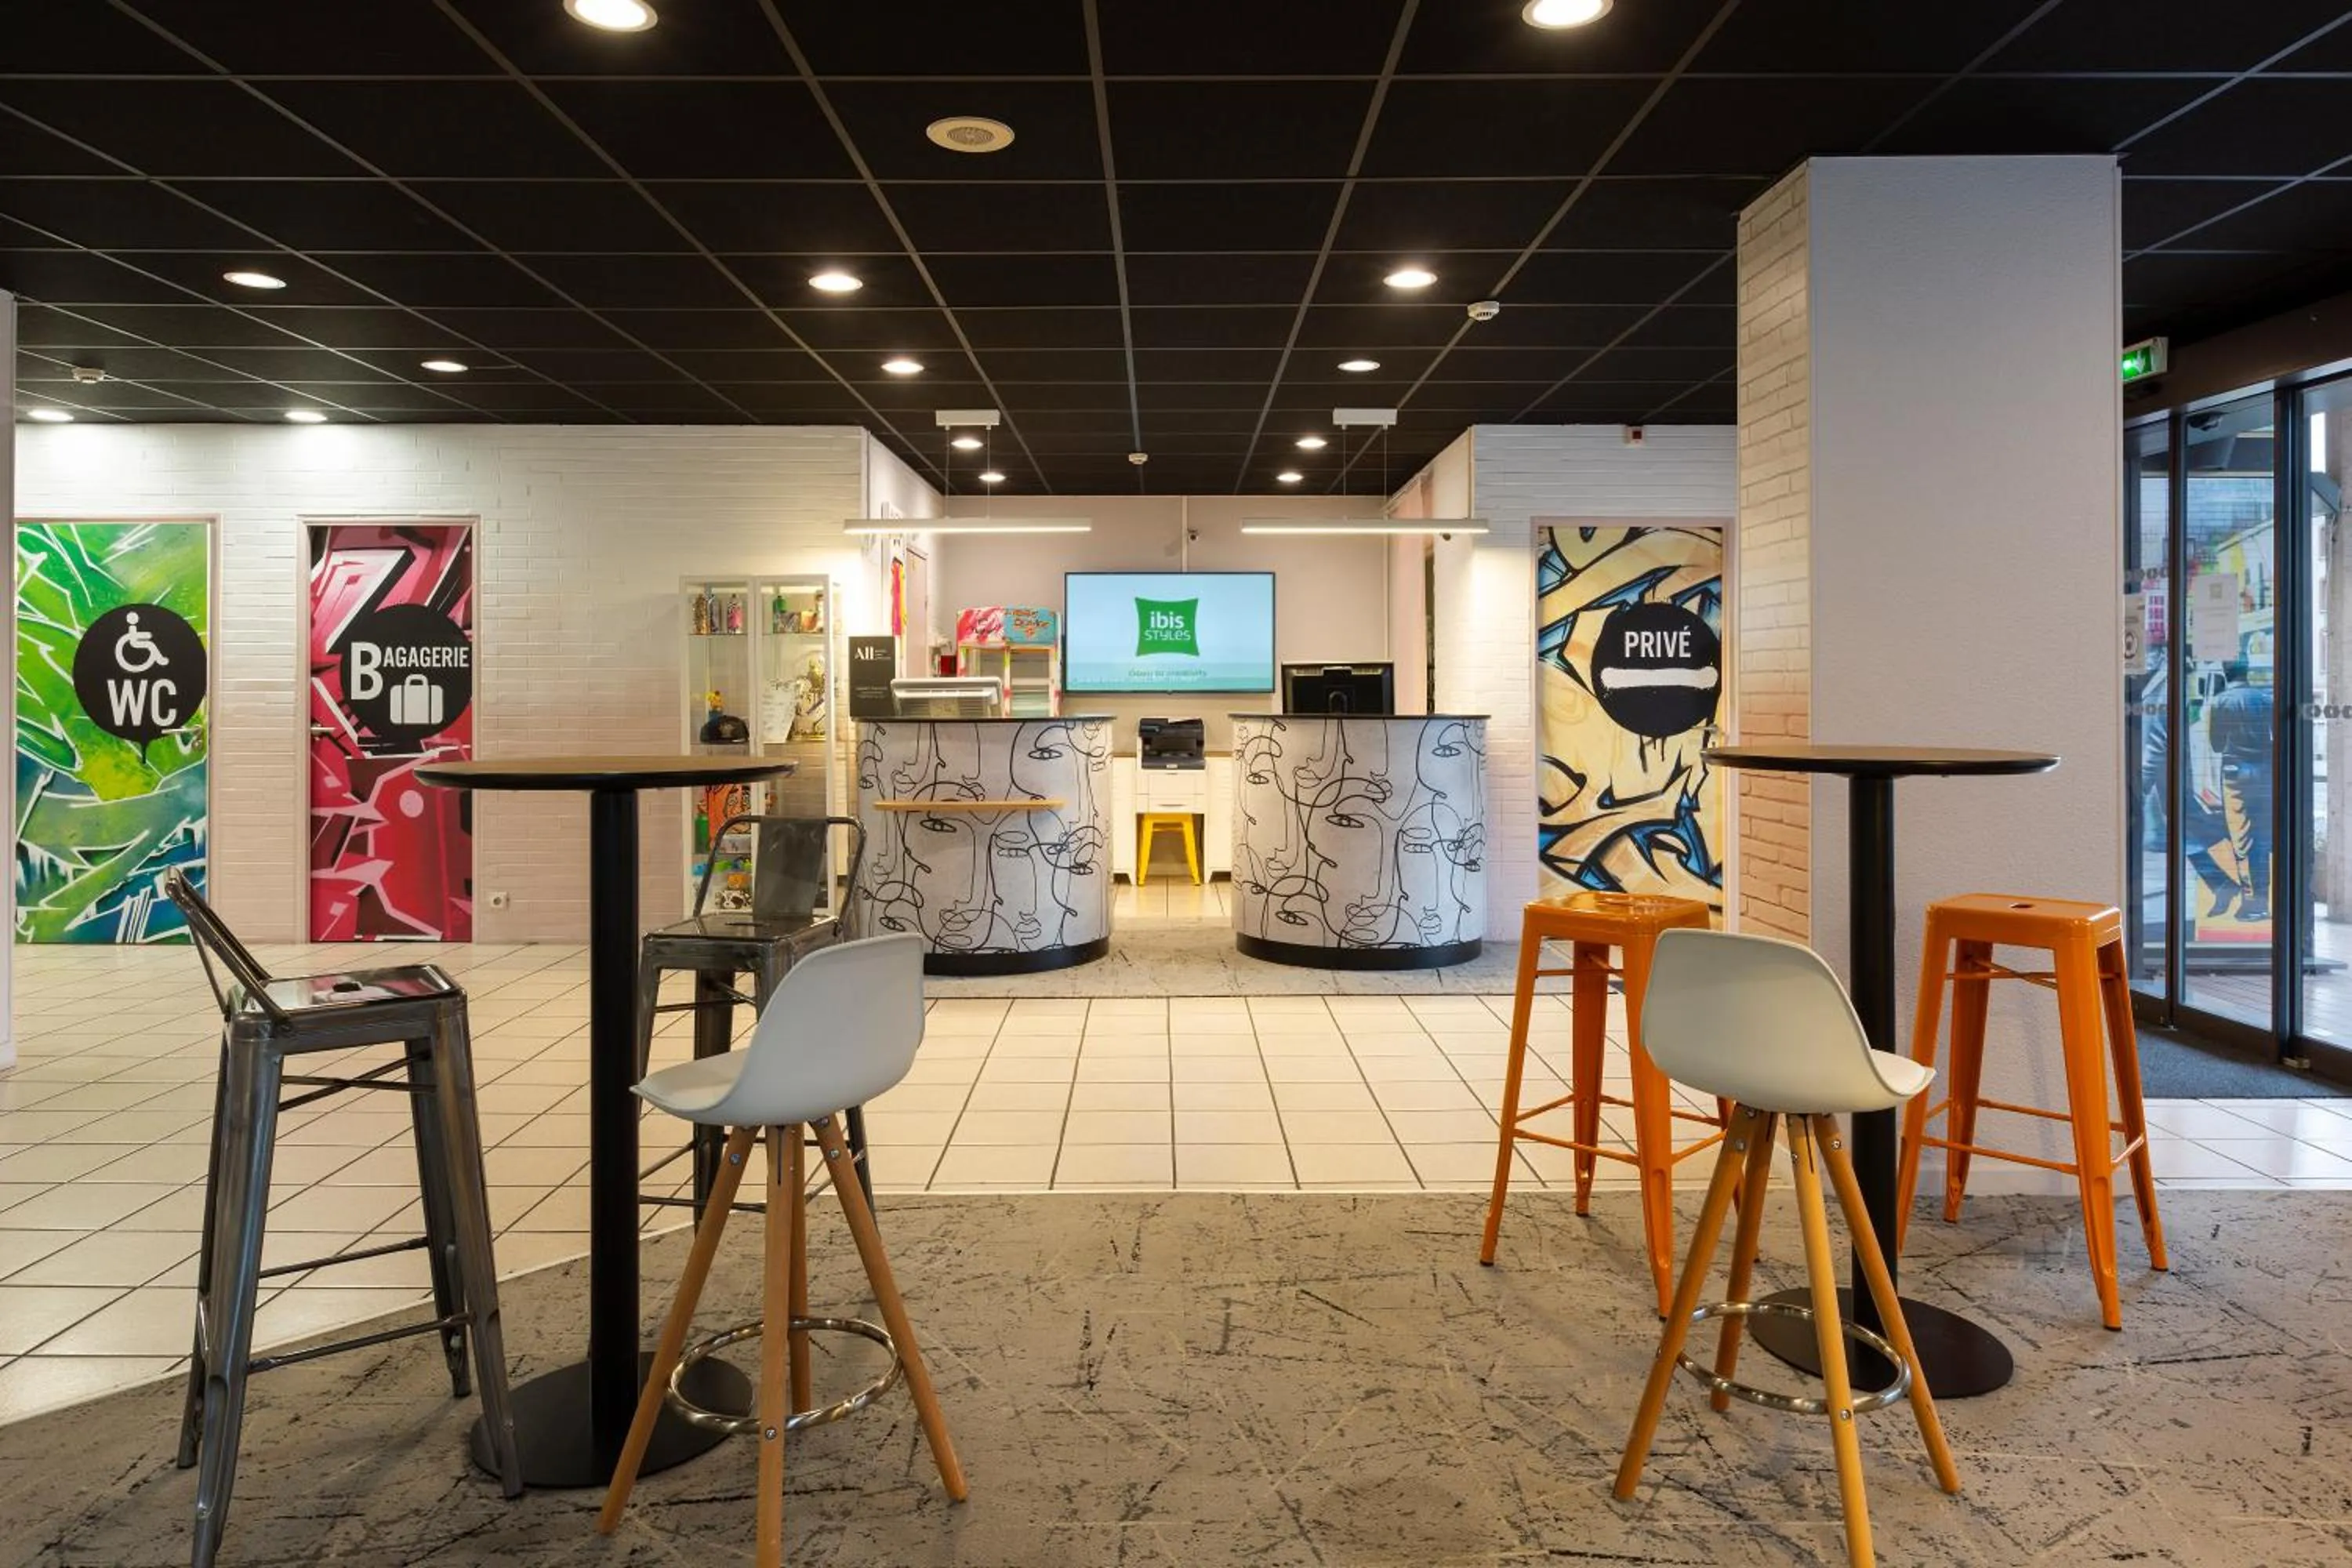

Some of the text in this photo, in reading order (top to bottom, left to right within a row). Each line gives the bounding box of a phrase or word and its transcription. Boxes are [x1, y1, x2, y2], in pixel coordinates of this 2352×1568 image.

[1150, 611, 1185, 629] ibis
[1624, 626, 1691, 658] PRIVÉ
[350, 641, 470, 700] BAGAGERIE
[107, 678, 177, 727] WC
